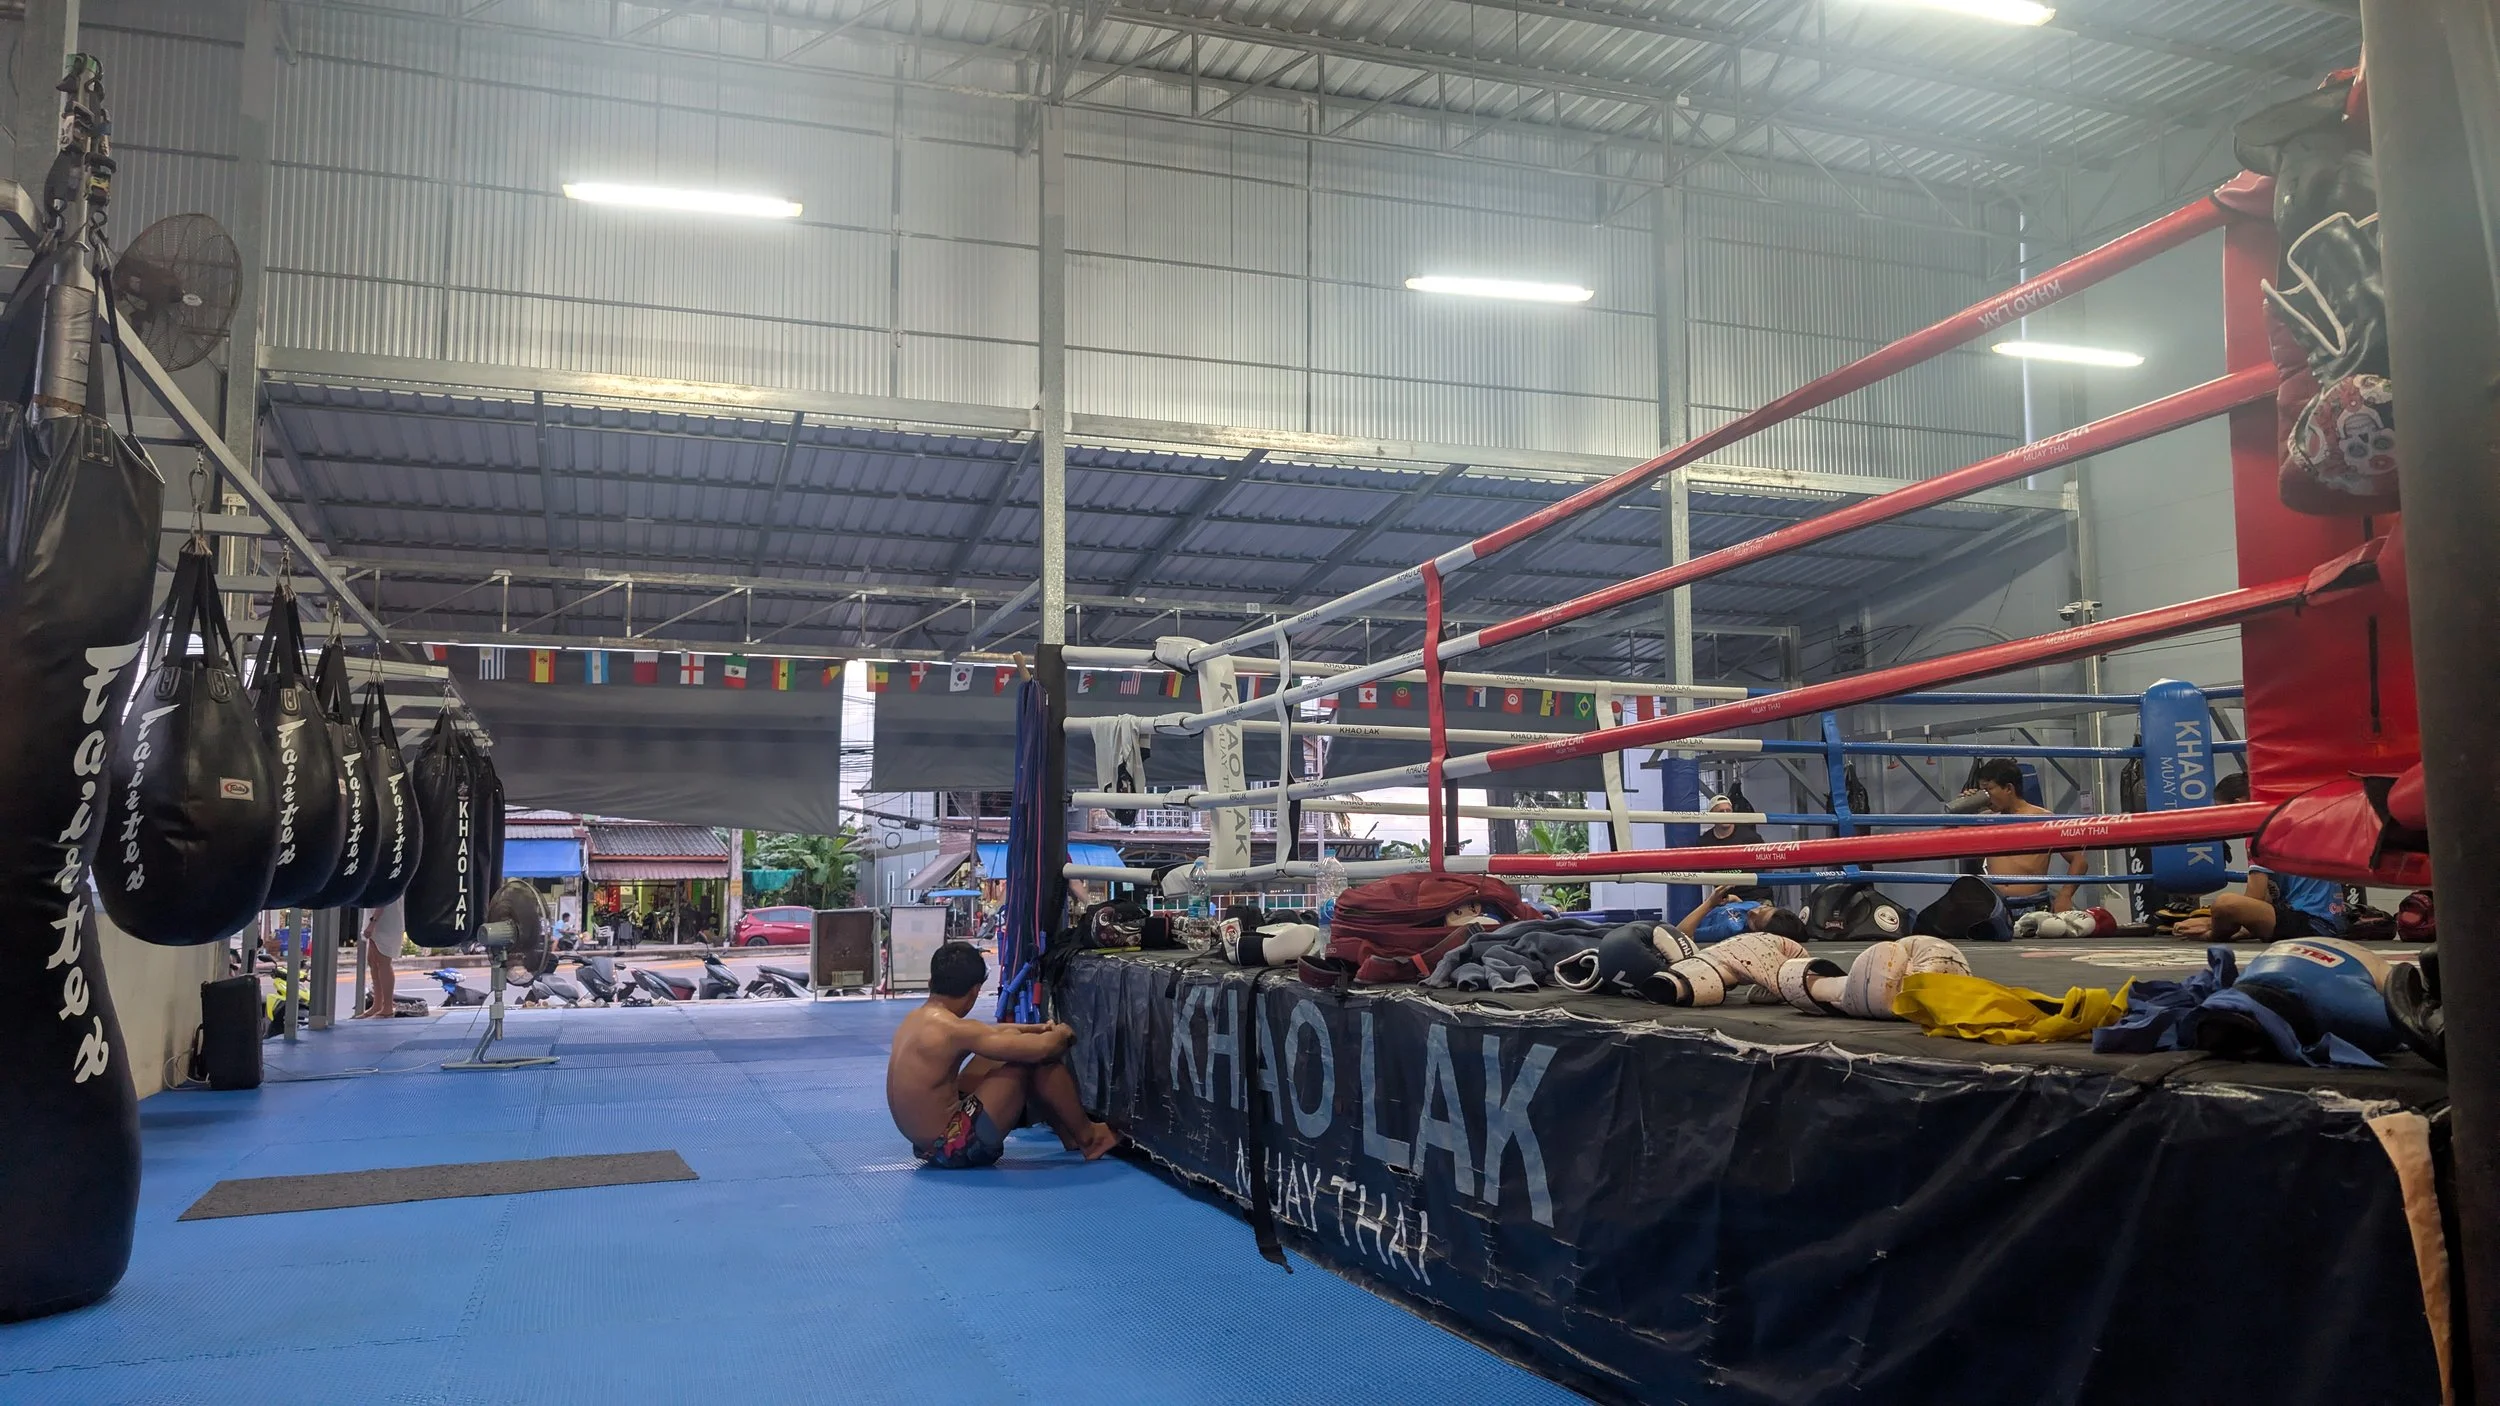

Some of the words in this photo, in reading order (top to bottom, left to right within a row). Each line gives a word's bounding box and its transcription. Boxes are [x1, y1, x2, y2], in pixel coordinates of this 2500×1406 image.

[1978, 301, 2014, 328] LAK
[2014, 279, 2063, 313] KHAO
[2024, 449, 2048, 462] MUAY
[2050, 442, 2069, 455] THAI
[1220, 682, 1241, 777] KAO
[1339, 727, 1362, 735] KHAO
[1751, 705, 1767, 714] MUAY
[1768, 702, 1781, 711] THAI
[120, 704, 180, 891] Fairtex
[277, 719, 307, 865] Fairtex
[2160, 757, 2176, 795] MUAY
[2175, 720, 2207, 800] KHAO
[46, 638, 146, 1084] Fairtex
[343, 752, 363, 876] Fairtex
[388, 772, 405, 879] Fairtex
[2060, 828, 2086, 837] MUAY
[2088, 826, 2109, 835] THAI
[455, 801, 469, 931] KHAOLAK
[1170, 985, 1335, 1138] KHAO
[1360, 1012, 1557, 1228] LAK
[1330, 1175, 1431, 1286] THAI
